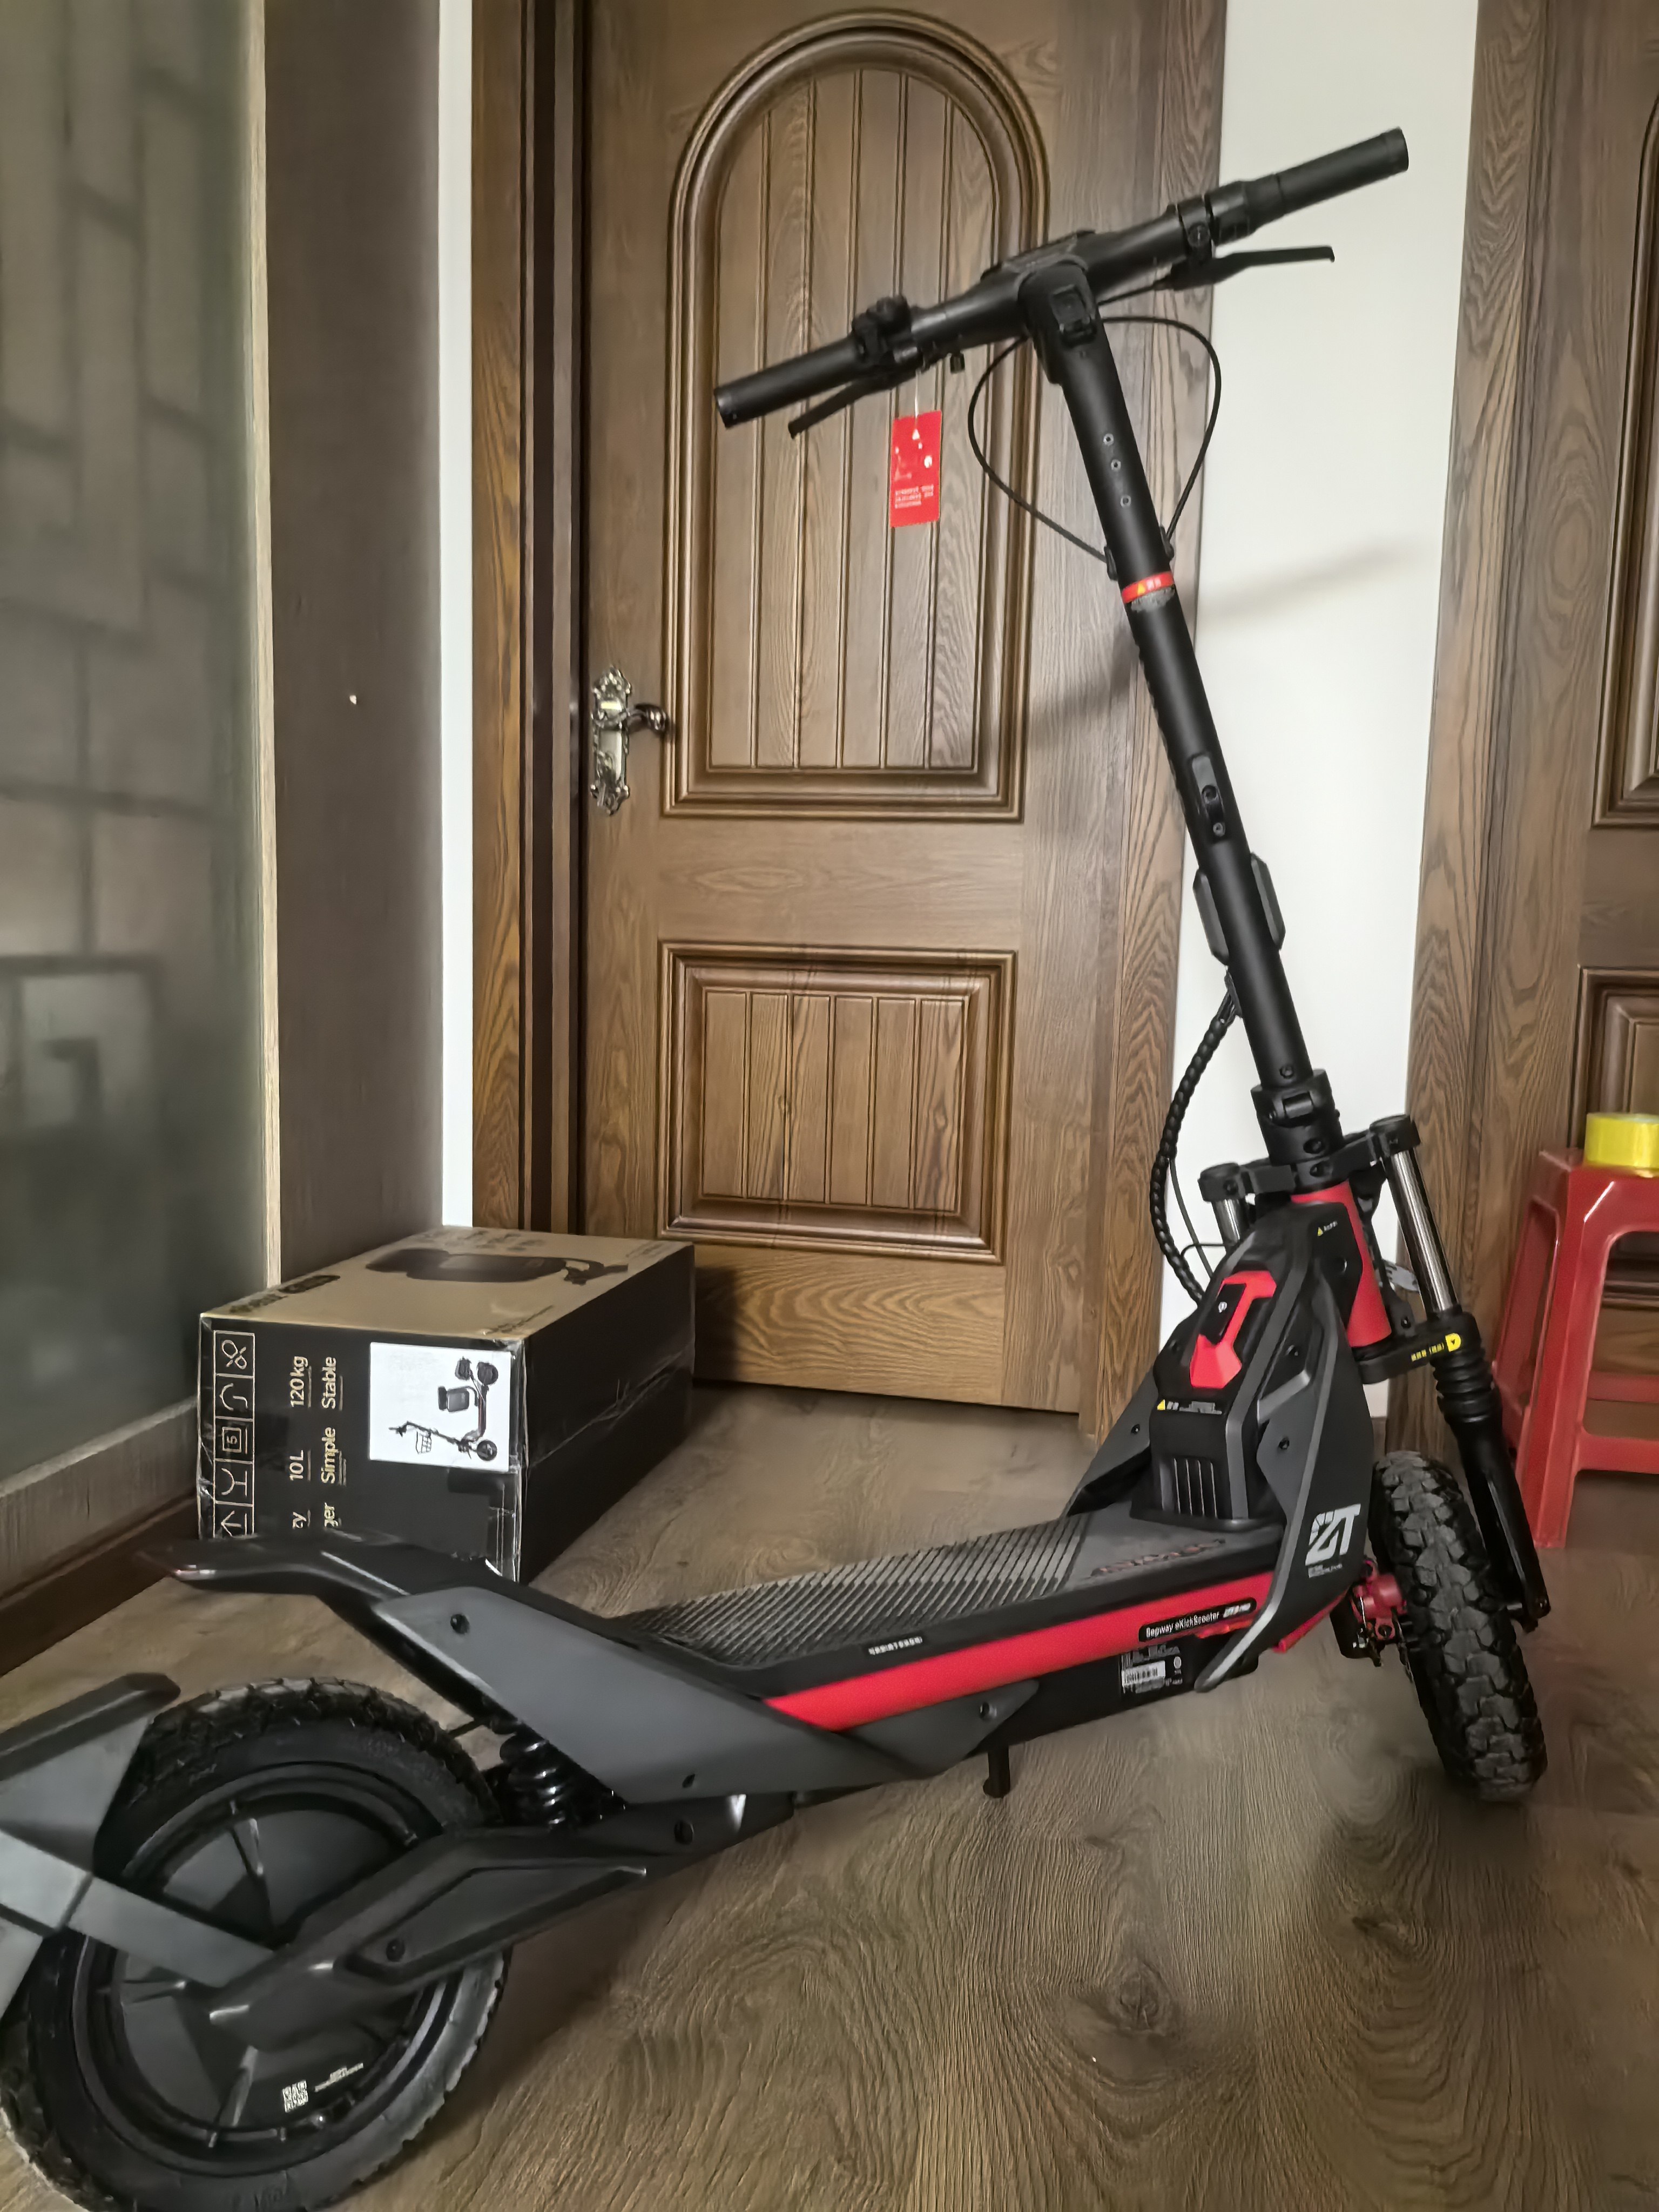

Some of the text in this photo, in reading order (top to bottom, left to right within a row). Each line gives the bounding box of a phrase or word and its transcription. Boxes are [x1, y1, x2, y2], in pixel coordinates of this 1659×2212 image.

[289, 1356, 308, 1407] 120kg
[321, 1357, 336, 1409] Stable
[321, 1427, 339, 1483] Simple
